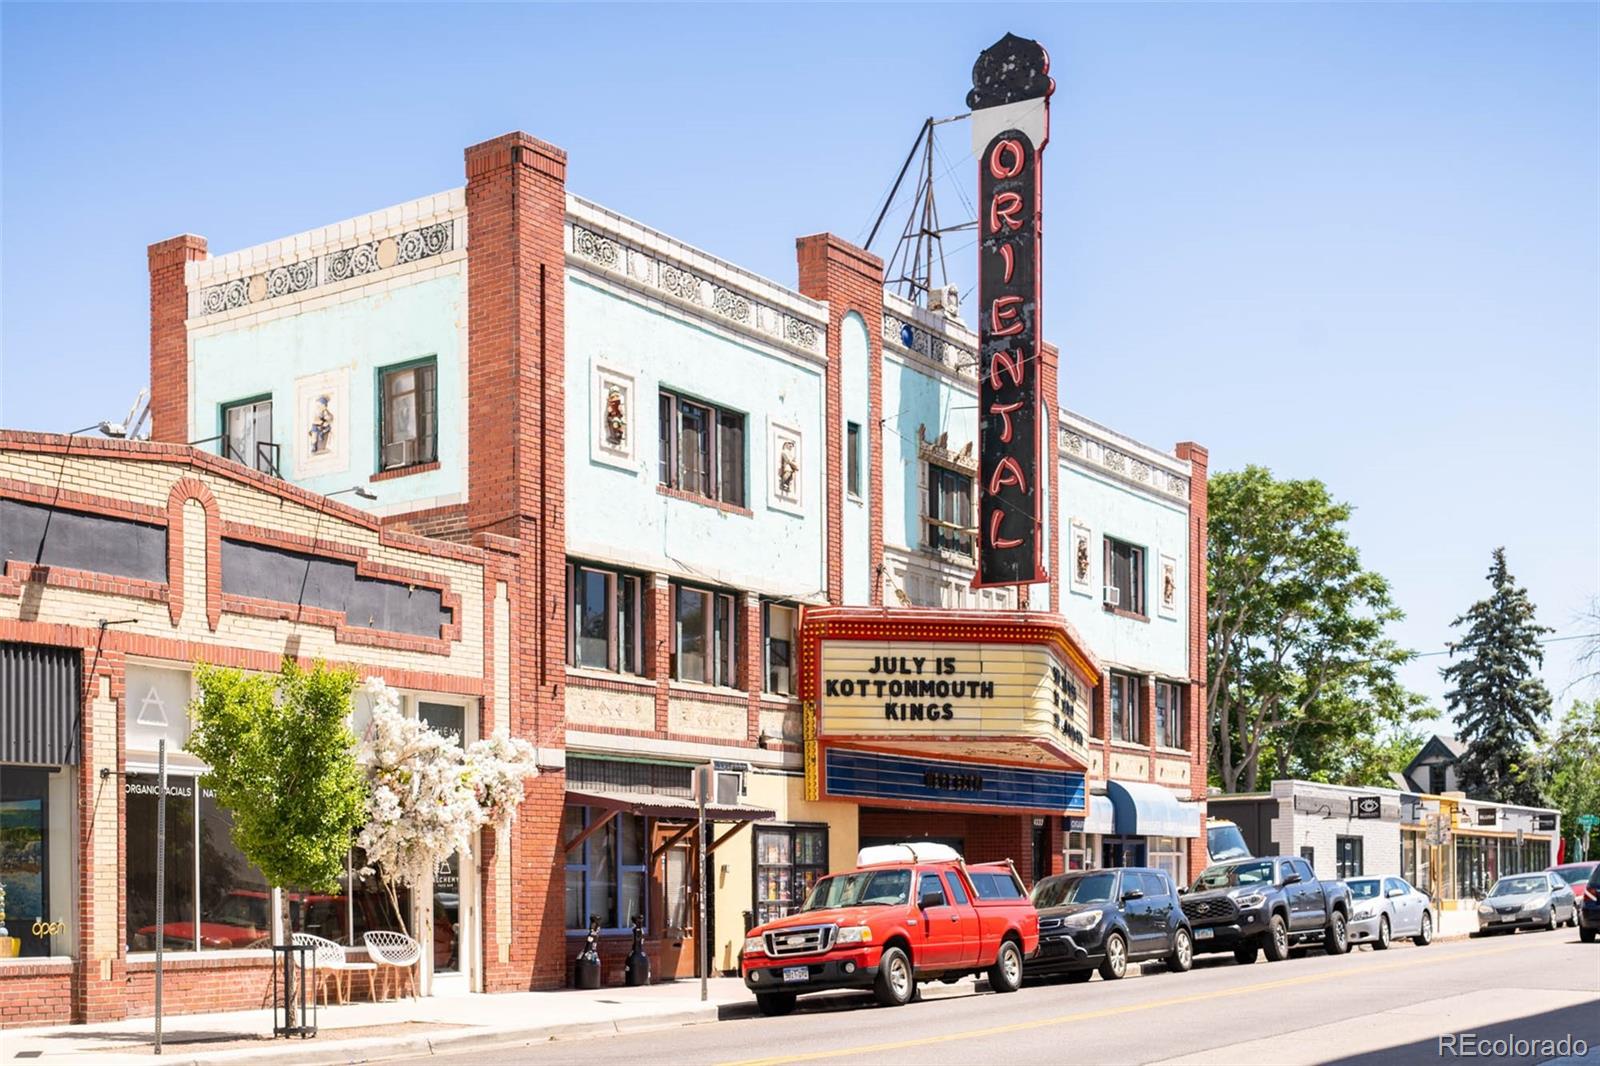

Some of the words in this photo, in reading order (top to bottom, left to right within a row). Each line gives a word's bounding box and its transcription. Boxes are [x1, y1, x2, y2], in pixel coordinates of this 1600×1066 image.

[989, 138, 1027, 550] ORIENTAL
[868, 656, 926, 675] JULY
[826, 679, 994, 699] KOTTONMOUTH
[885, 702, 954, 721] KINGS
[125, 783, 160, 796] ORGANIC
[162, 786, 192, 797] ACIALS
[32, 922, 65, 939] open
